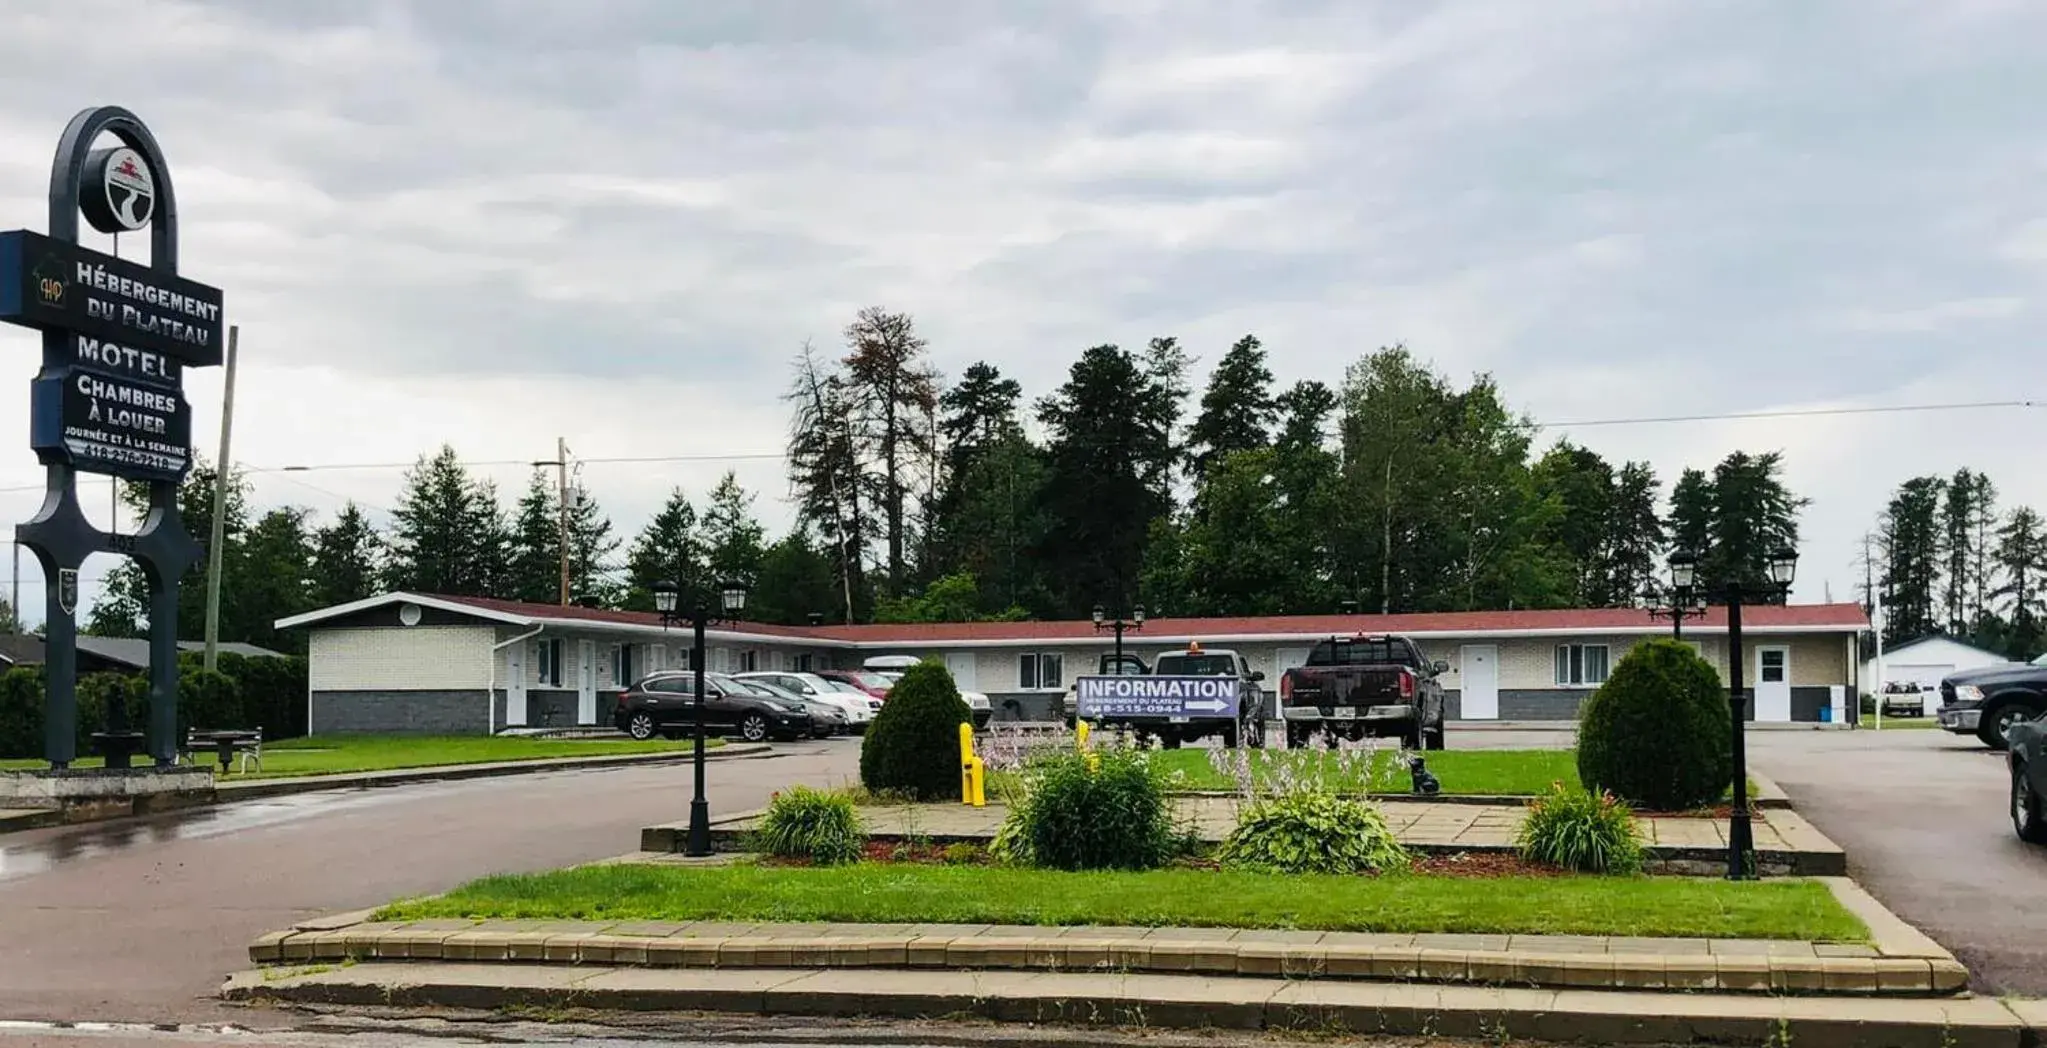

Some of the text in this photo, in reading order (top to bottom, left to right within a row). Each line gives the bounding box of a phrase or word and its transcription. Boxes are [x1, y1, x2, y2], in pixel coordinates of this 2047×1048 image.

[77, 262, 218, 321] HÉBERGEMENT
[87, 298, 209, 346] DU PLATEAU
[77, 336, 175, 380] MOTEL
[77, 375, 176, 413] CHAMBRES
[88, 399, 166, 434] À LOUER
[65, 426, 186, 456] JOURNÉE ET À LA SEMAINE
[1081, 680, 1234, 697] INFORMATION
